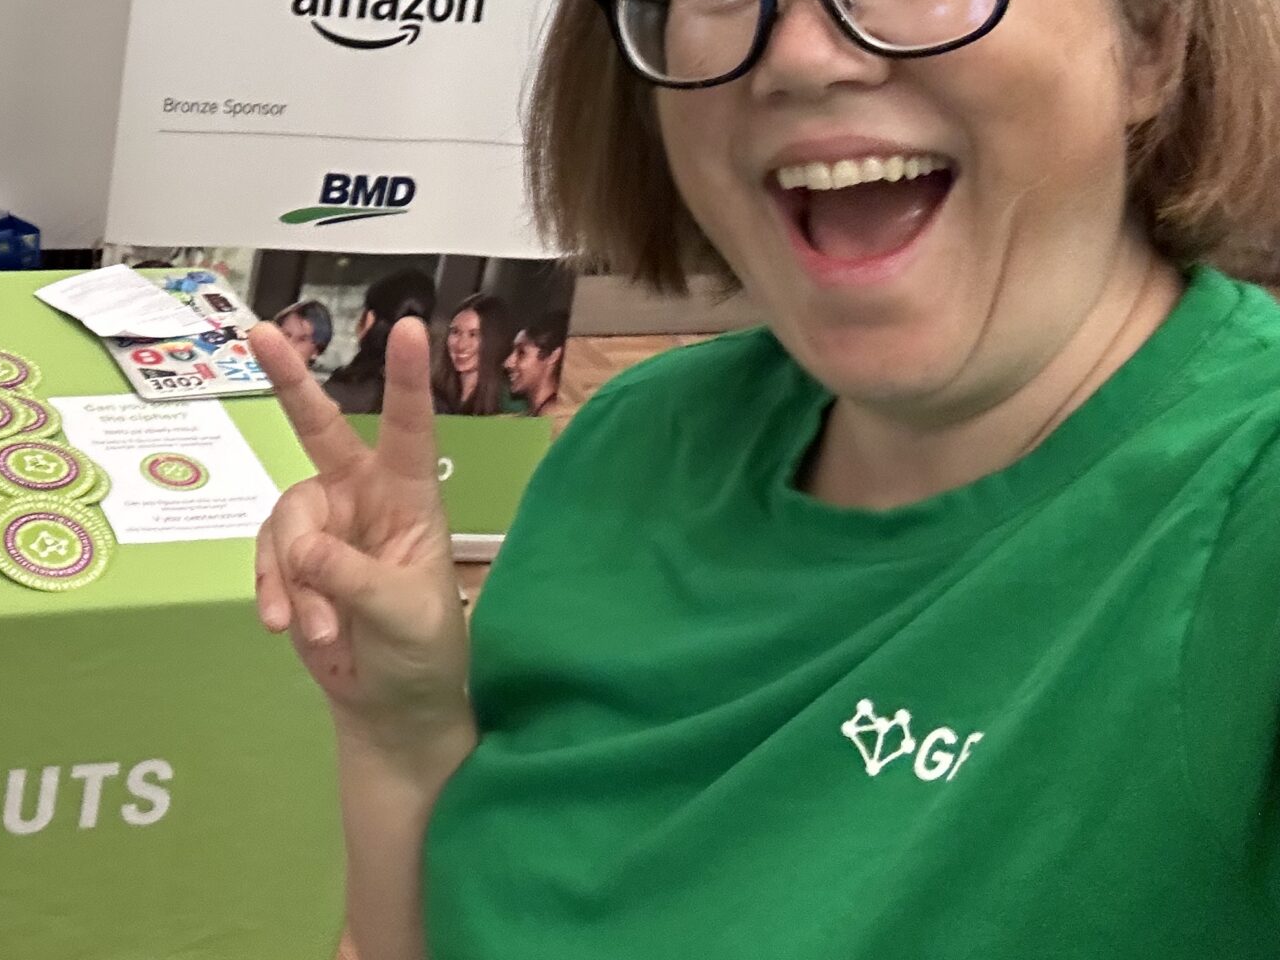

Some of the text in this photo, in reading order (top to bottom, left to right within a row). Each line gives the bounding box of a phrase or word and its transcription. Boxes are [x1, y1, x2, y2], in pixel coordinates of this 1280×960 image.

[163, 96, 287, 120] Bronze Sponsor
[319, 173, 418, 208] BMD
[1, 758, 175, 836] UTS
